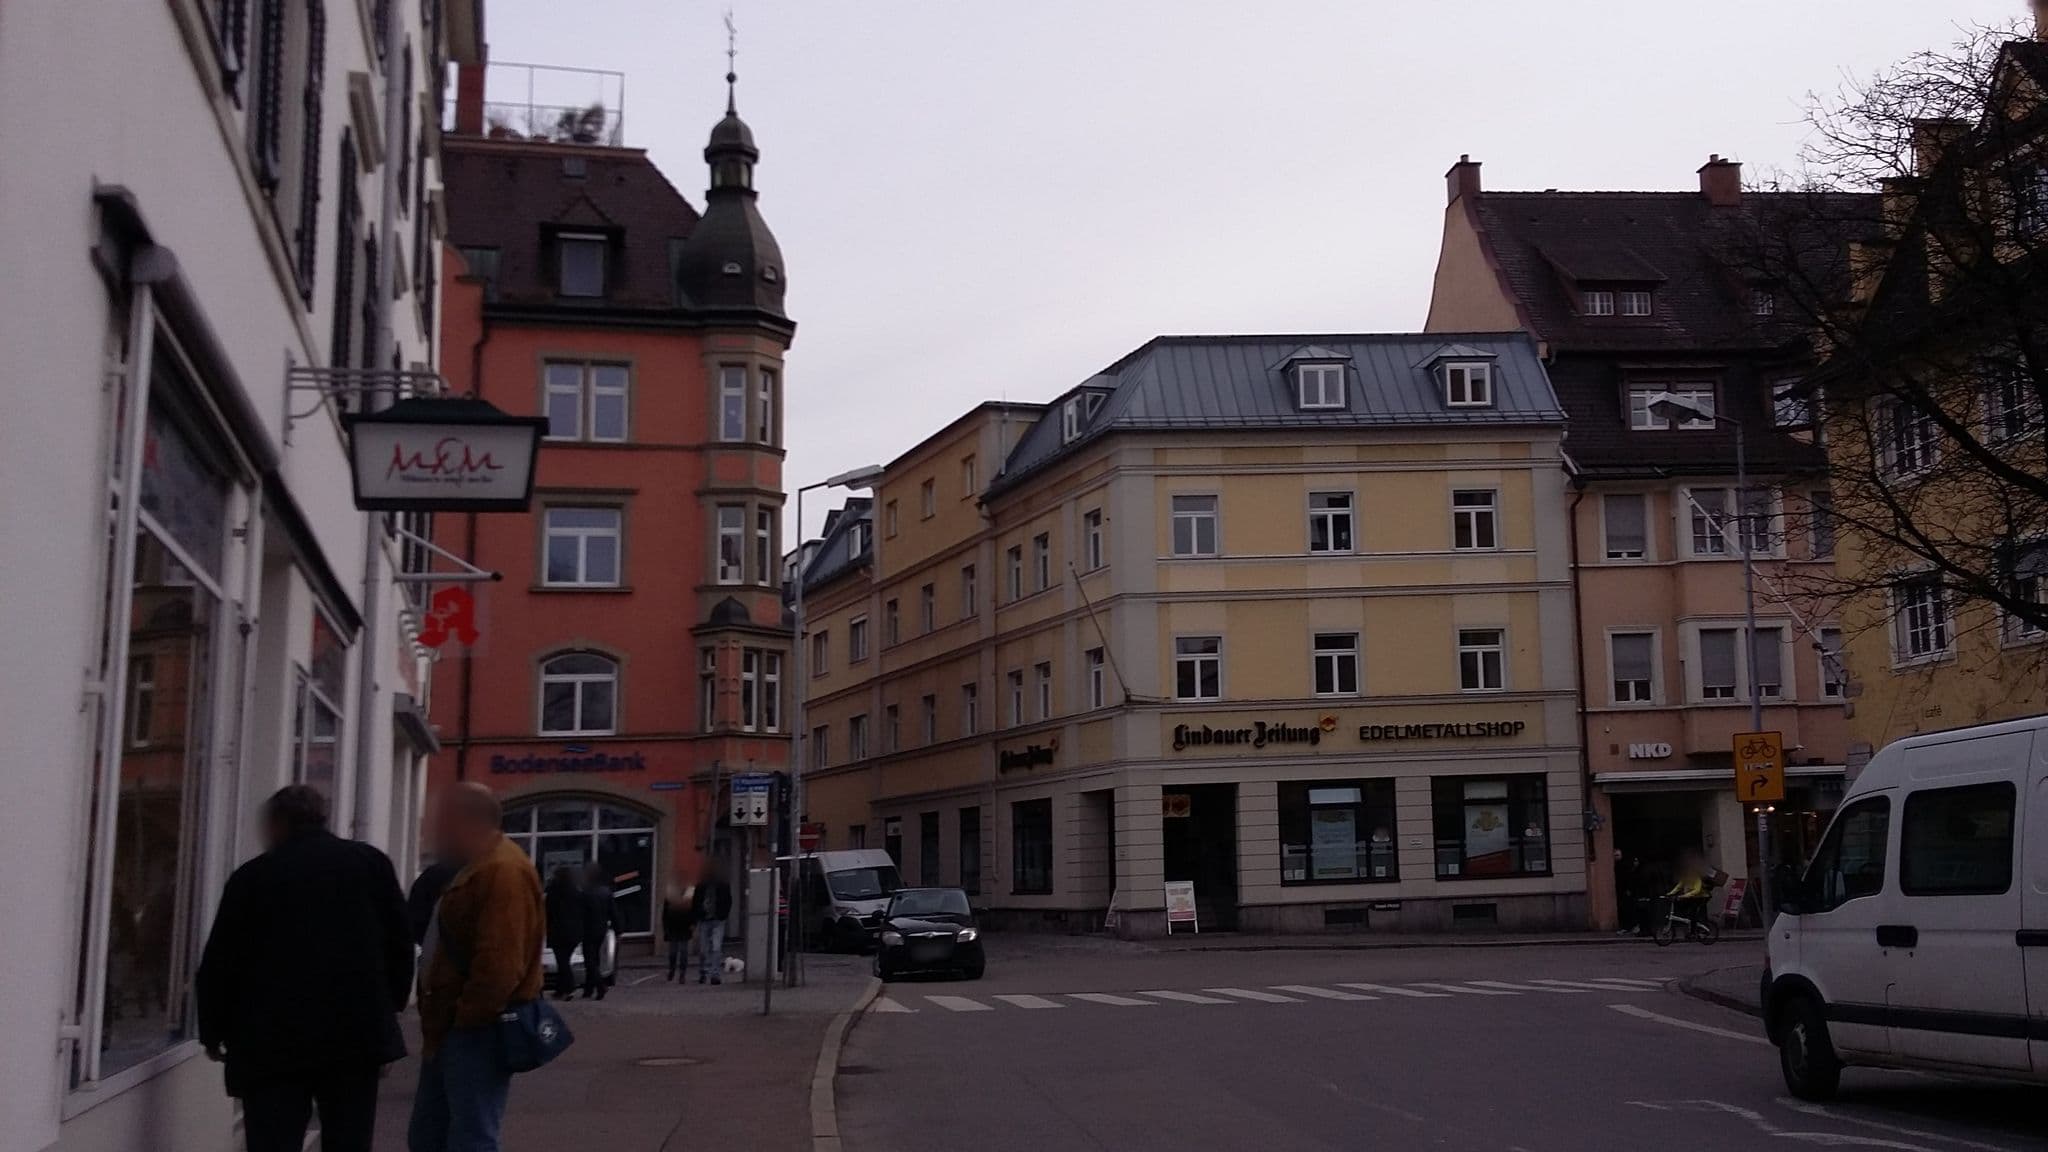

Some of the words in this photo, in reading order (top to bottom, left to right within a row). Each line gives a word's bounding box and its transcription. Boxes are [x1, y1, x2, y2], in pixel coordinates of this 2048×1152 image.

[1173, 723, 1252, 751] Lindauer
[1253, 721, 1321, 749] Zeitung
[1359, 721, 1525, 741] EDELMETALLSHOP
[1630, 743, 1673, 759] NKD
